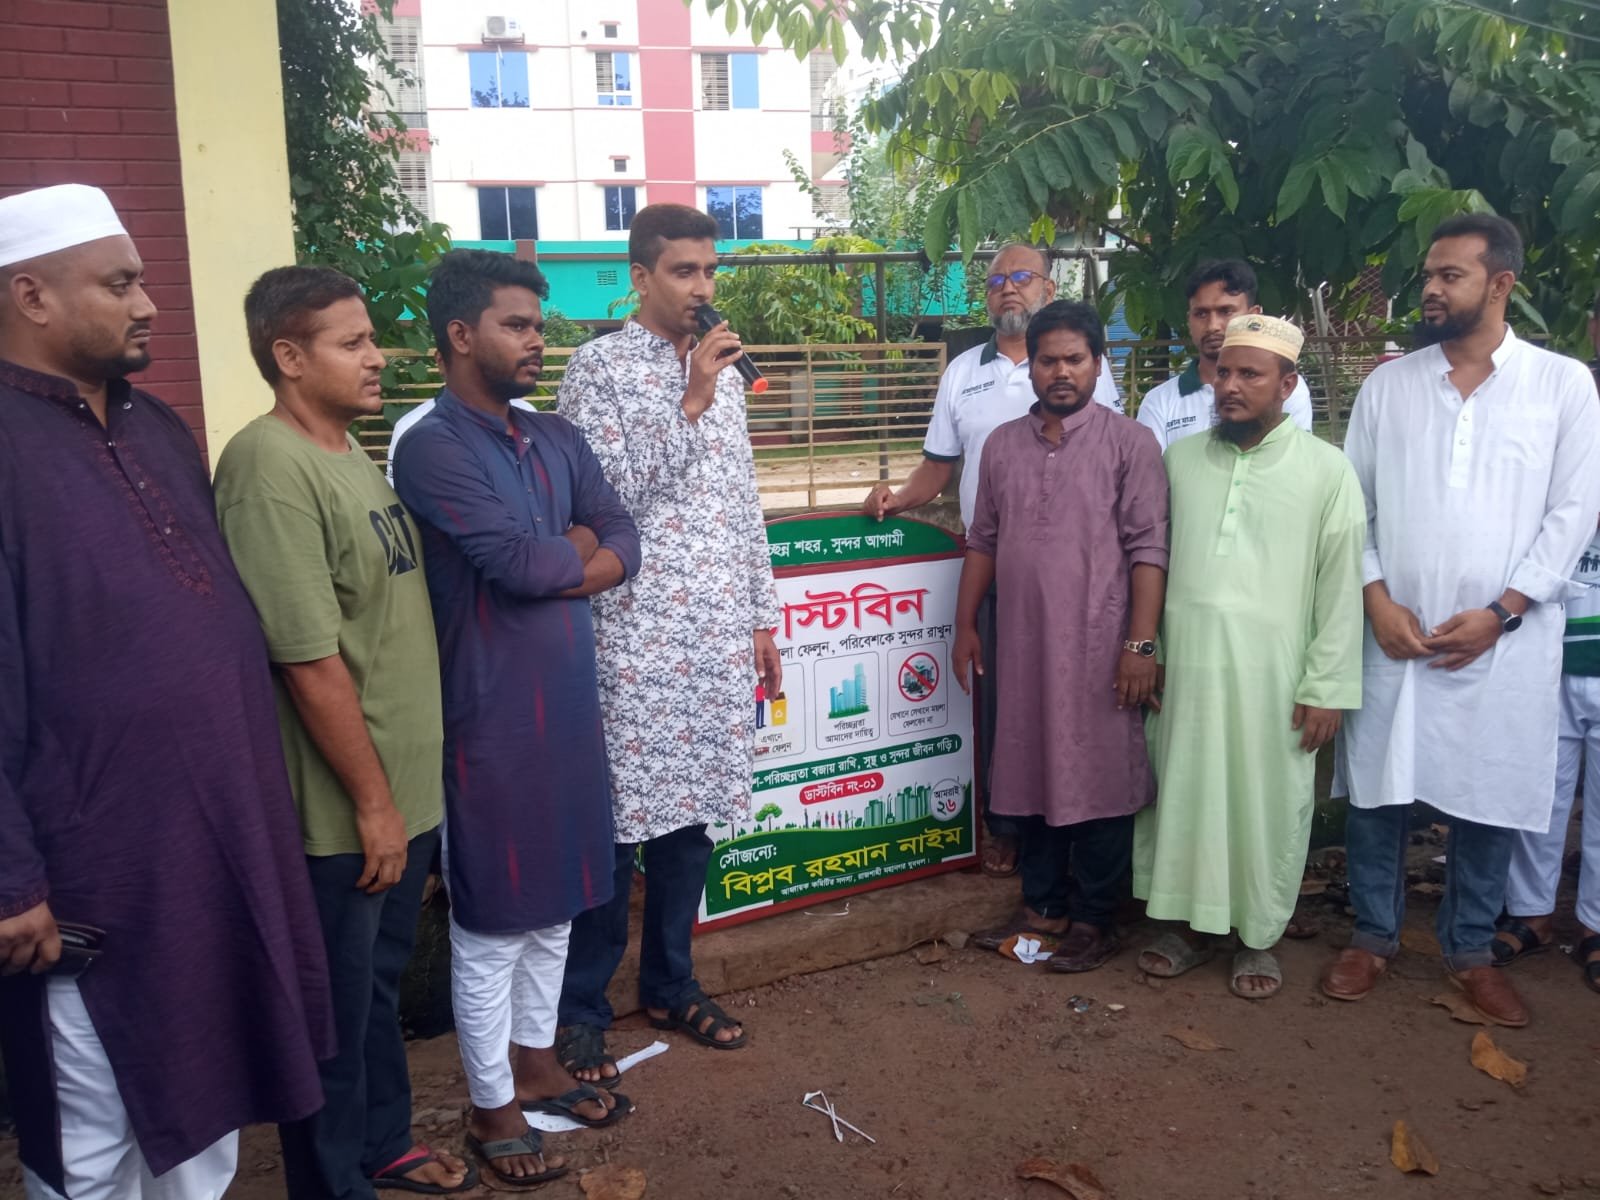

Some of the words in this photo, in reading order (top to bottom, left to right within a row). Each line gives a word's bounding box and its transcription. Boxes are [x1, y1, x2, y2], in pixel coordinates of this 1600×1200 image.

[369, 503, 418, 576] CAT
[768, 542, 791, 557] চ্ছন্ন
[794, 539, 828, 555] শহর,
[831, 536, 861, 554] সুন্দর
[864, 529, 904, 548] আগামী
[769, 582, 928, 640] াস্টবিন
[798, 641, 836, 657] ফেলুন,
[839, 633, 894, 651] পরিবেশকে
[898, 628, 923, 645] সুন্দর
[927, 624, 952, 640] রাখুন
[825, 732, 853, 744] আমাদের
[811, 763, 835, 777] বজায়
[837, 757, 861, 773] রাখি,
[879, 754, 887, 764] ও
[889, 749, 910, 764] সুন্দর
[912, 742, 934, 757] জীবন
[804, 782, 844, 801] ডাস্টবিন
[847, 779, 876, 795] নং-০১
[937, 799, 956, 816] ২৬
[720, 864, 796, 899] বিপ্লব
[803, 842, 890, 878] রহমান
[897, 826, 963, 855] নাইম
